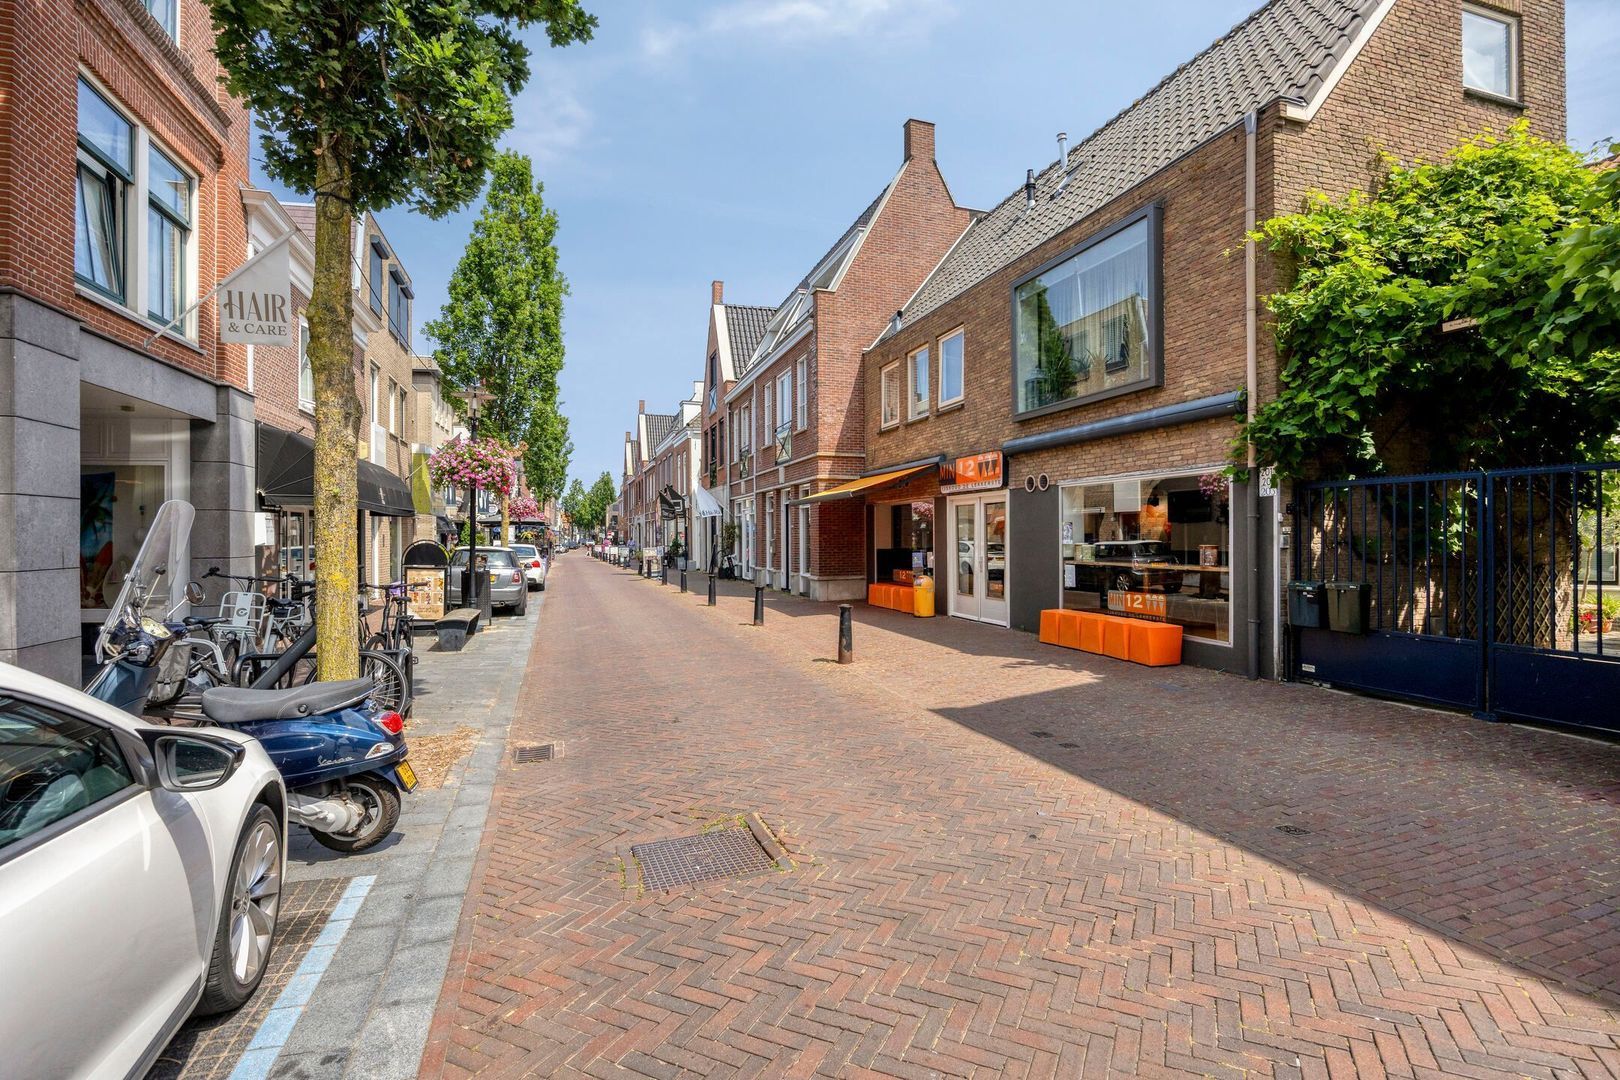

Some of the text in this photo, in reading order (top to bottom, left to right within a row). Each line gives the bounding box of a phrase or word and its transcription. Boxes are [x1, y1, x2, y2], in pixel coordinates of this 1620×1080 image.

[223, 289, 288, 323] HAIR
[228, 321, 288, 336] & CARE
[940, 460, 976, 480] MIN 12
[1126, 594, 1143, 608] 12
